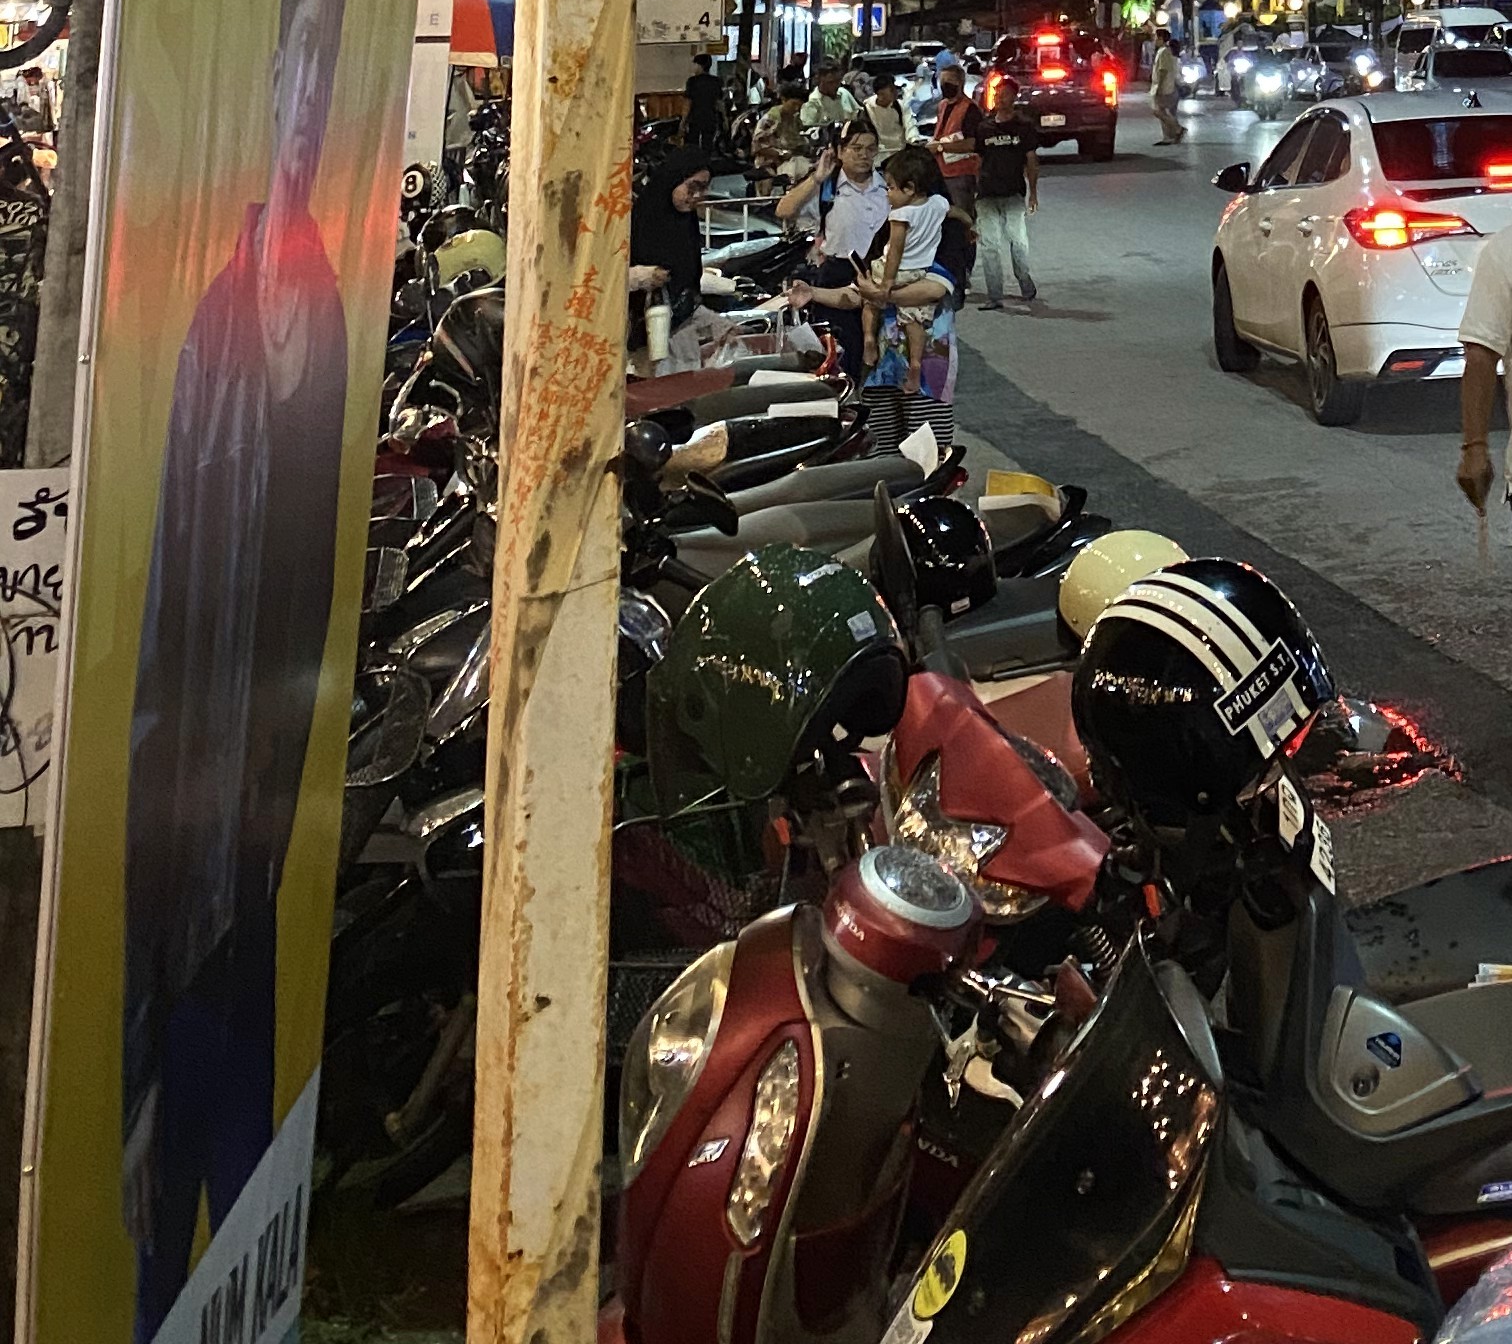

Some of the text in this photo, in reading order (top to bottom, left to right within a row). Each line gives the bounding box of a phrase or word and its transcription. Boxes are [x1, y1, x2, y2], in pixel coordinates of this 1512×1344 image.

[429, 13, 440, 26] E
[699, 12, 711, 28] 4
[405, 174, 417, 194] 8
[1224, 651, 1292, 723] PHUKET S.T.
